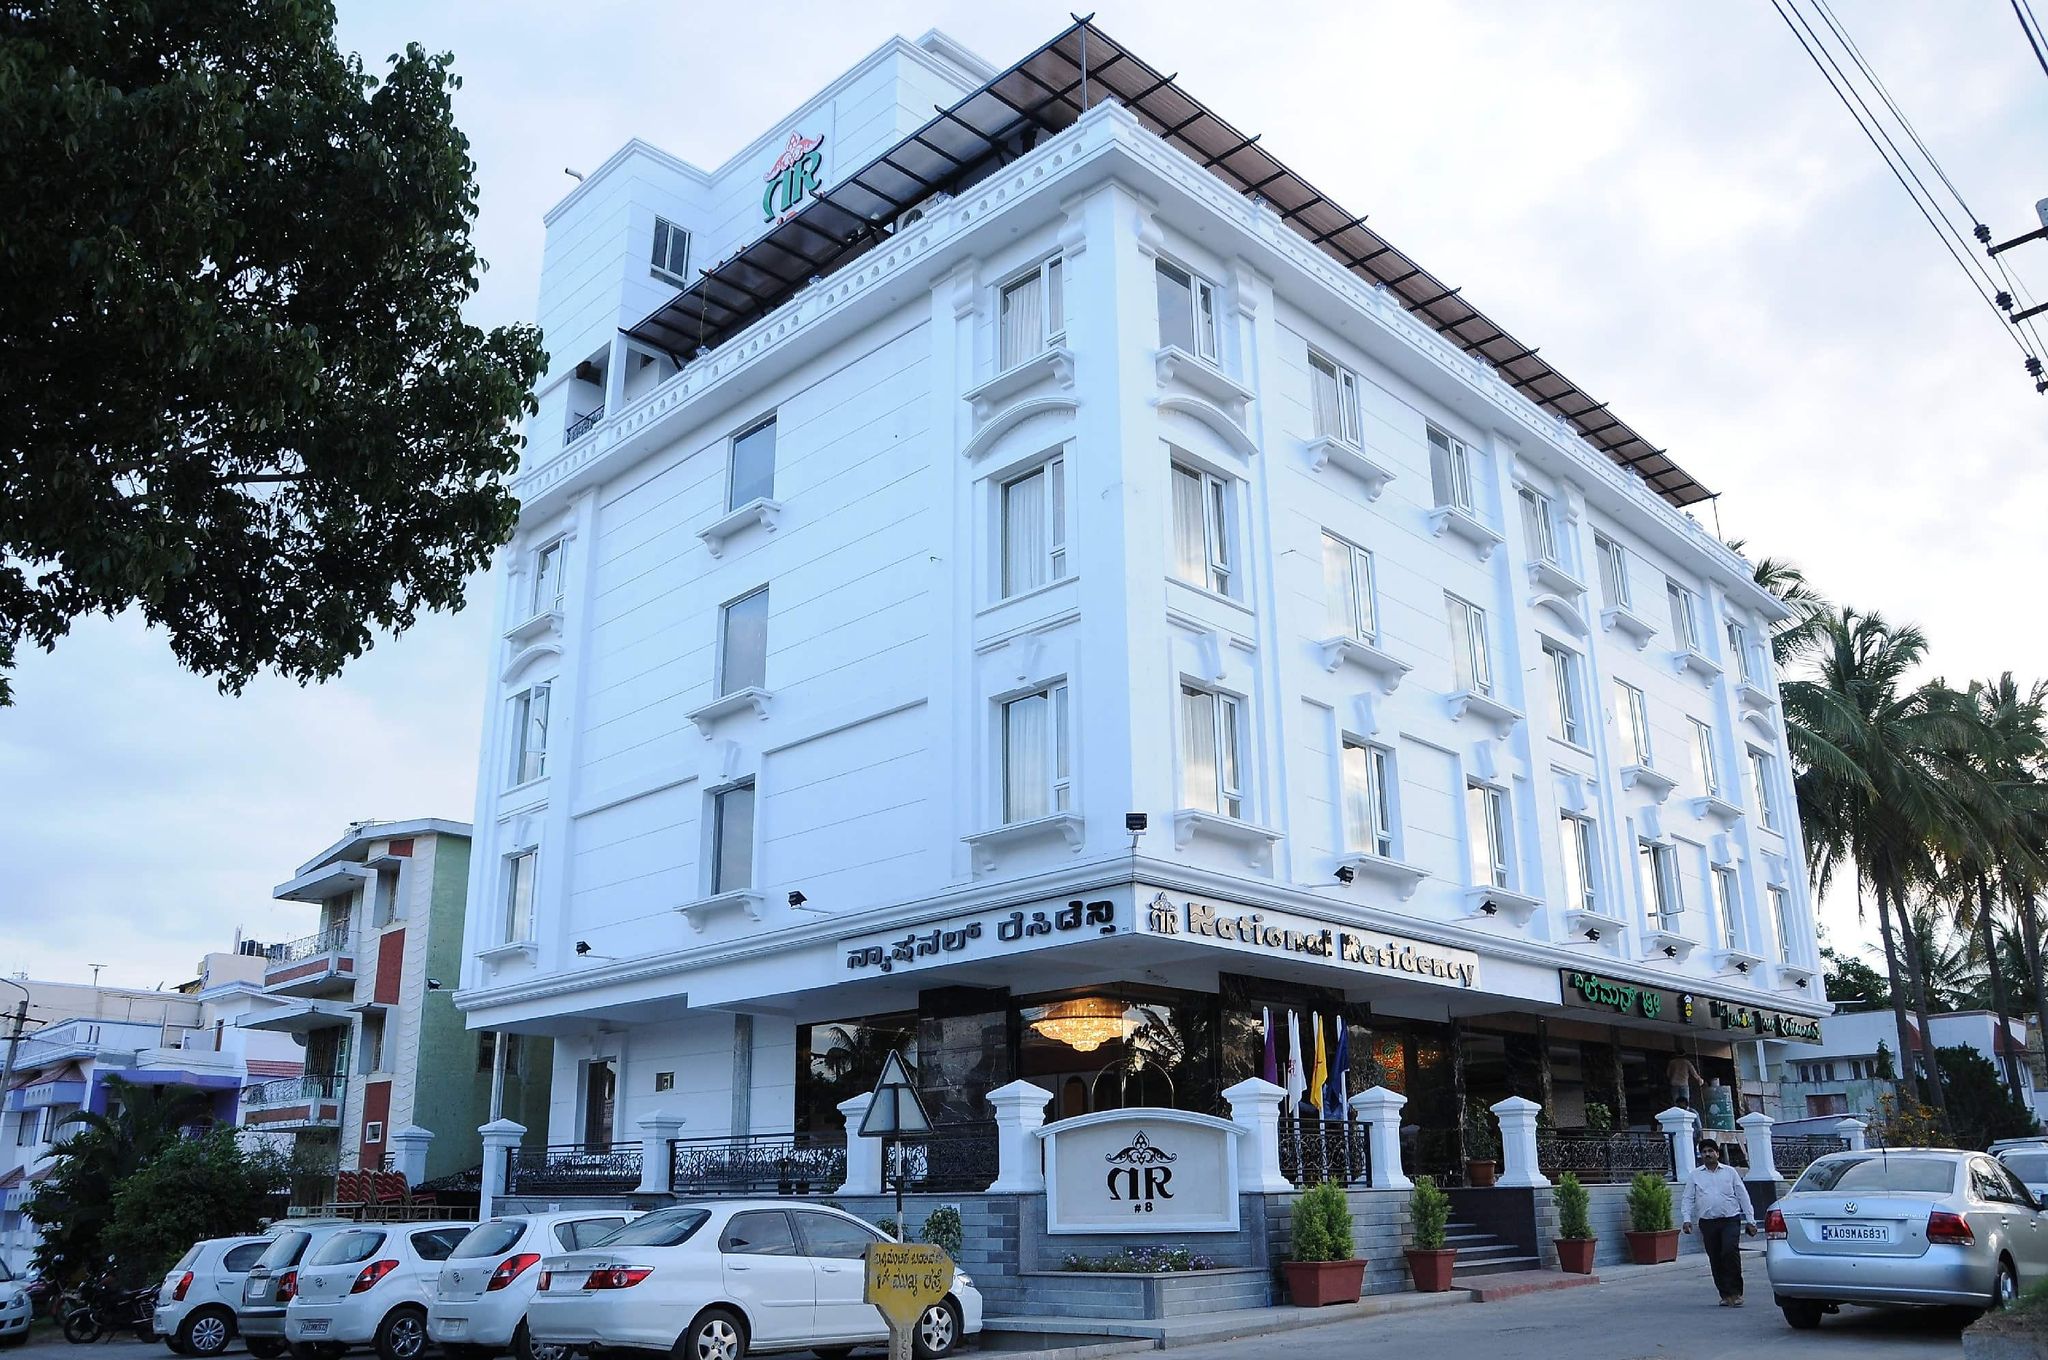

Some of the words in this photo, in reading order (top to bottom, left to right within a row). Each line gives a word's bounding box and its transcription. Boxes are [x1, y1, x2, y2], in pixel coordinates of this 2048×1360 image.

[846, 921, 982, 973] ನ್ಯಾಷನಲ್
[1187, 902, 1334, 958] National
[1341, 933, 1475, 988] Residency
[1827, 1228, 1887, 1239] KA09MA6831
